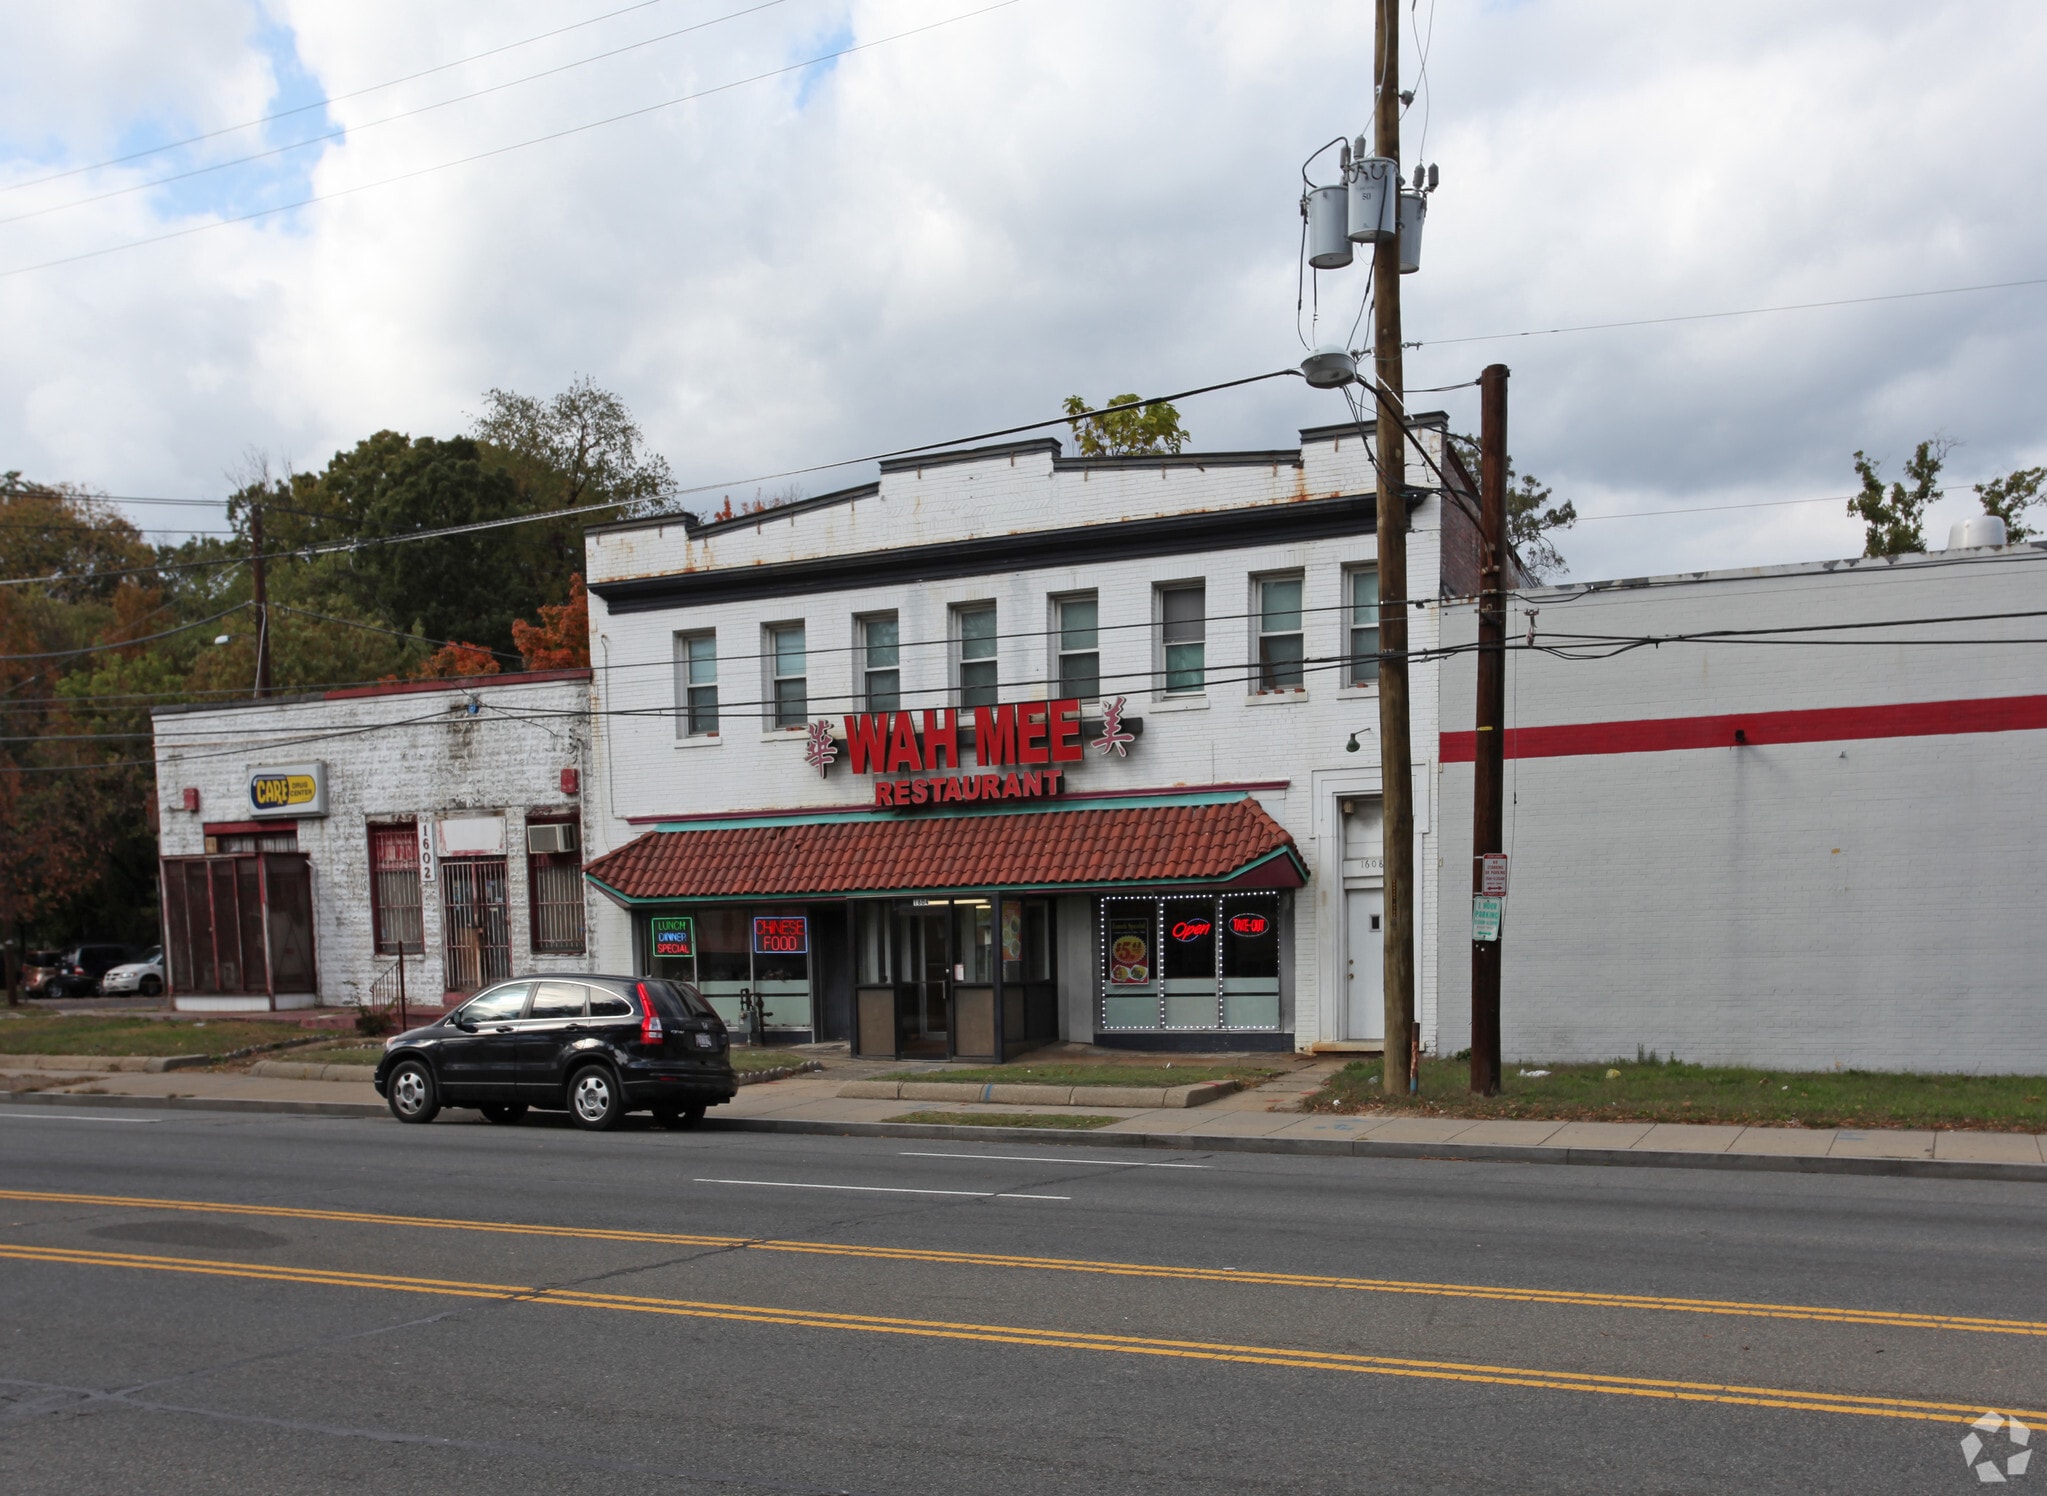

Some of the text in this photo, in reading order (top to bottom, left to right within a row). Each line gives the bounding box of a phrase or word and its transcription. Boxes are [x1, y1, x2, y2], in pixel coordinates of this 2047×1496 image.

[1090, 696, 1135, 757] 美
[843, 698, 1084, 774] WAH MEE
[256, 779, 288, 805] CARE
[290, 789, 312, 797] CENTER
[875, 769, 1063, 806] RESTAURANT
[422, 824, 431, 879] 1602
[1474, 910, 1498, 919] PARKING
[658, 921, 686, 930] LUNCH
[755, 920, 805, 935] CHINESE
[1172, 921, 1211, 940] Open
[1233, 919, 1265, 932] TAKE-OUT
[659, 932, 687, 942] DINNER
[763, 935, 797, 951] FOOD
[657, 943, 690, 953] SPECIAL
